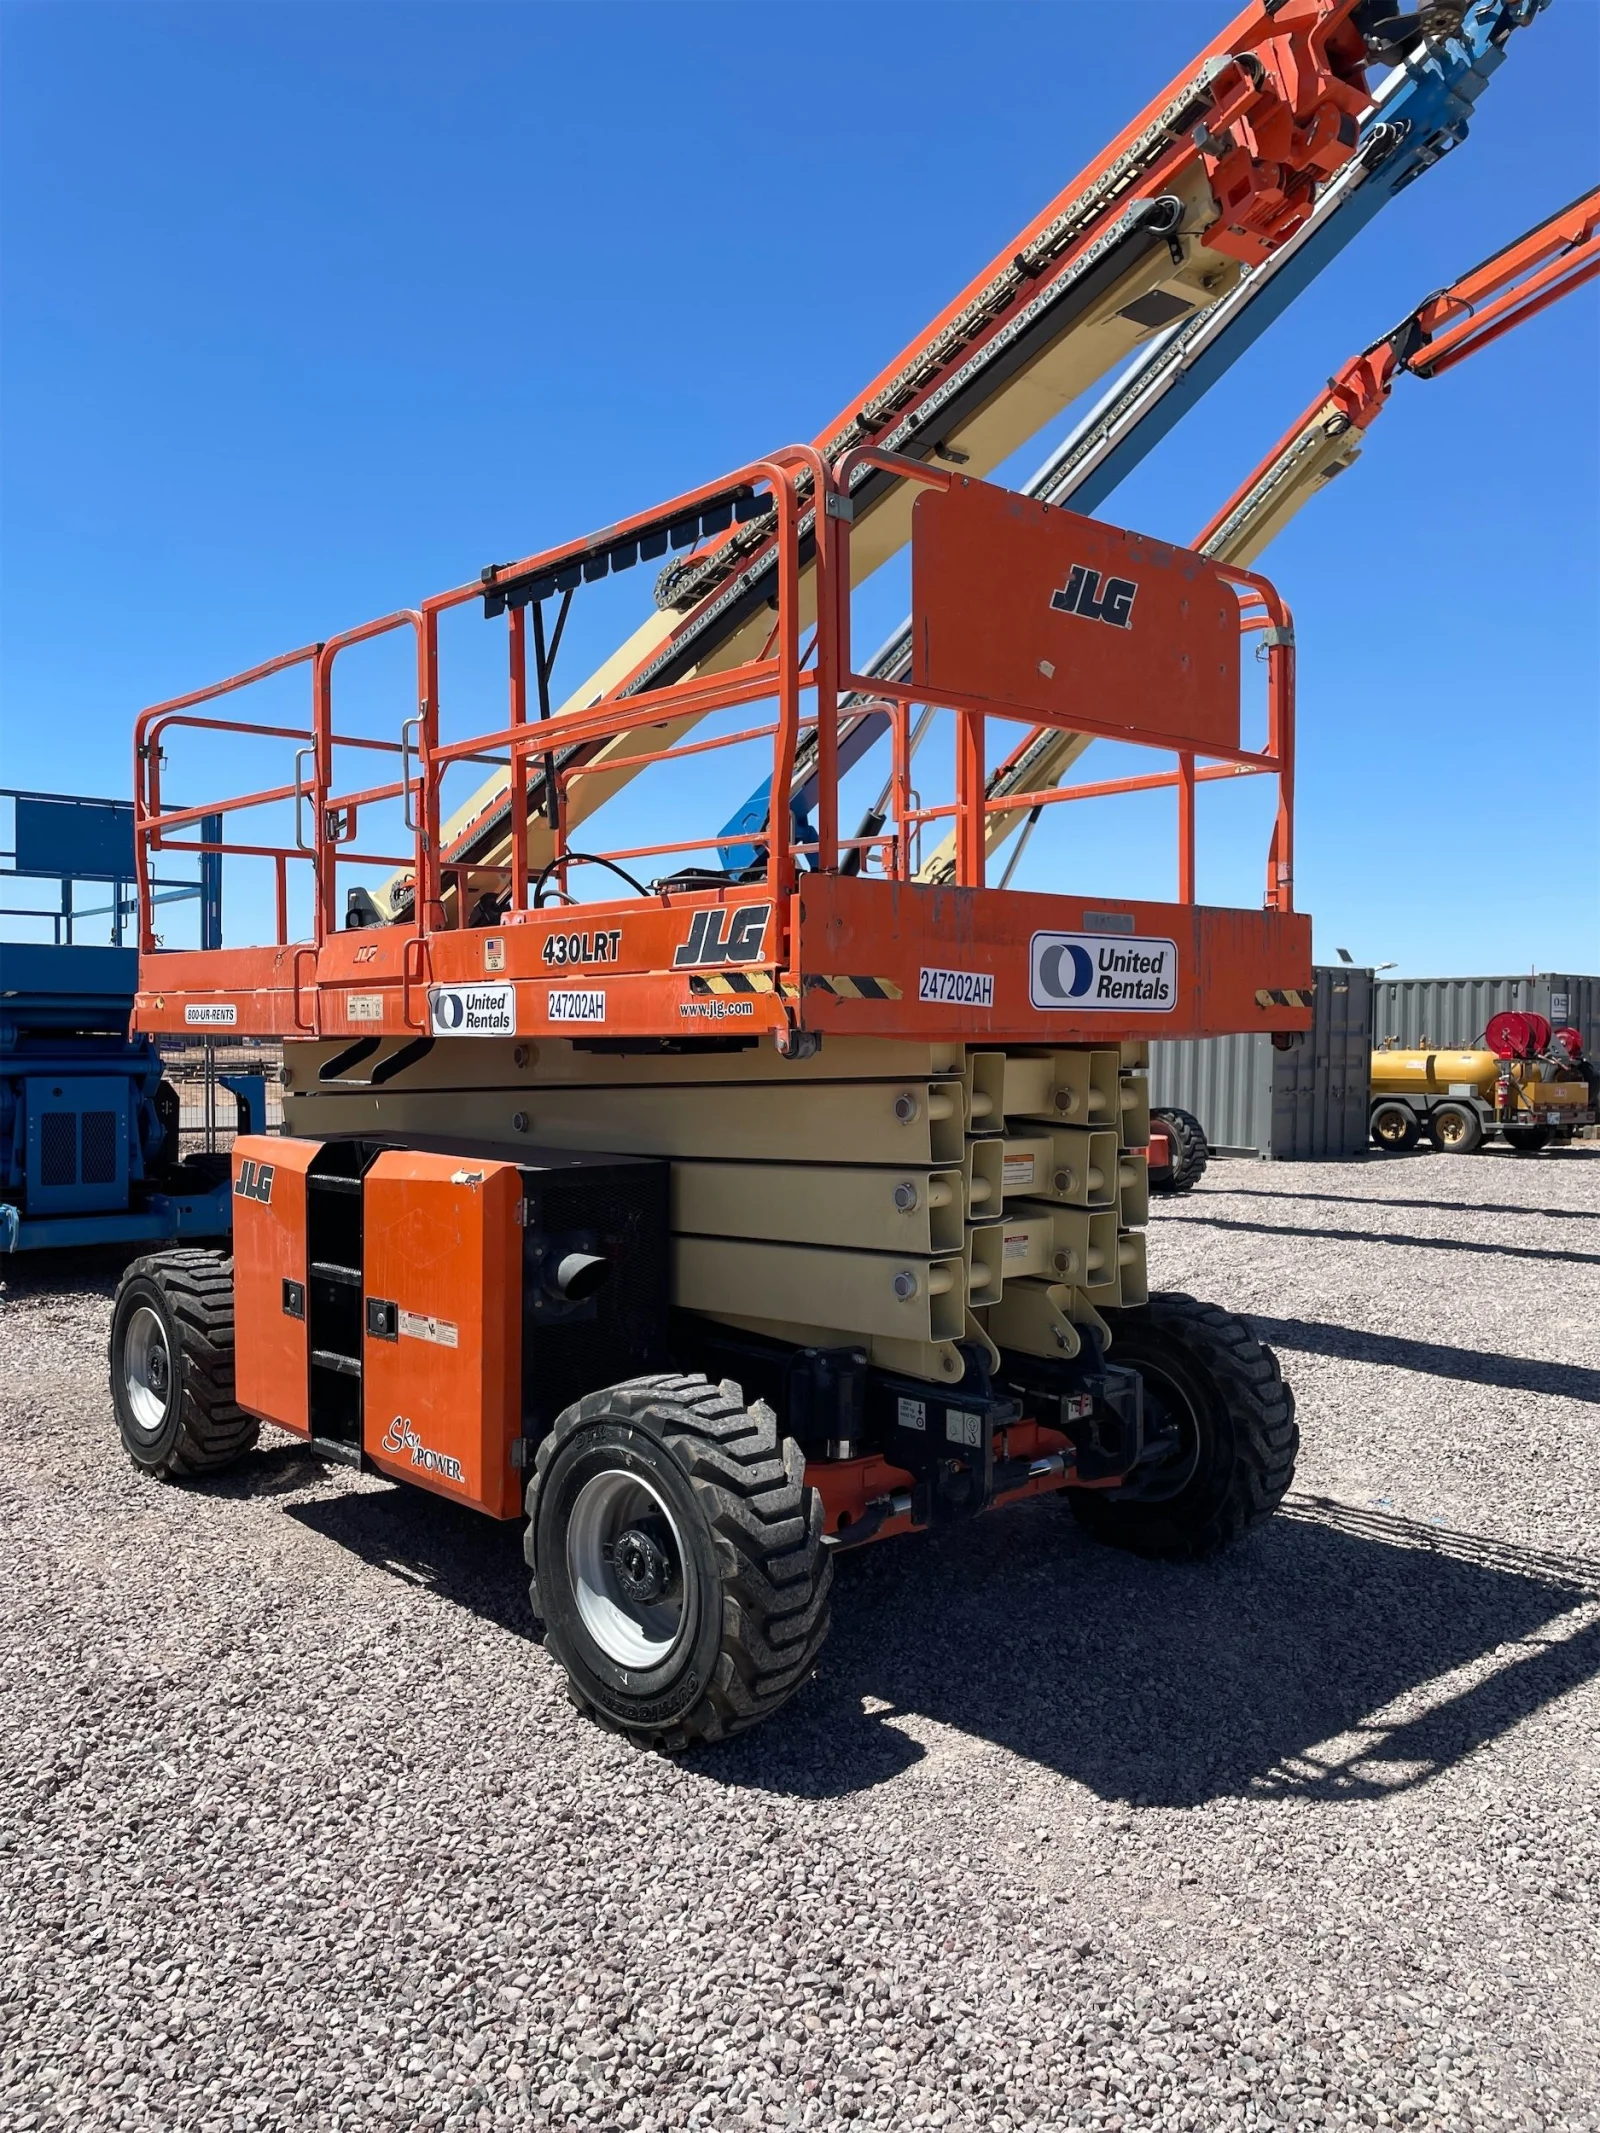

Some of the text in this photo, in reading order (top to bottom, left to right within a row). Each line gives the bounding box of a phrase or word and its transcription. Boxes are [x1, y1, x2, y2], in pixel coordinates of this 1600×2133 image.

[1049, 564, 1138, 629] JLG
[542, 929, 622, 966] 430LRT
[673, 904, 771, 967] JLG
[1097, 947, 1164, 974] United
[920, 970, 993, 1004] 247202AH
[1096, 975, 1169, 1000] Rentals
[187, 1009, 234, 1020] 800-UR-RENTS
[466, 993, 506, 1010] United
[549, 993, 604, 1019] 247202AH
[680, 1000, 753, 1019] www.jlg.com
[466, 1011, 510, 1029] Rentals
[233, 1159, 275, 1204] JLG
[382, 1416, 462, 1481] Sky POWER
